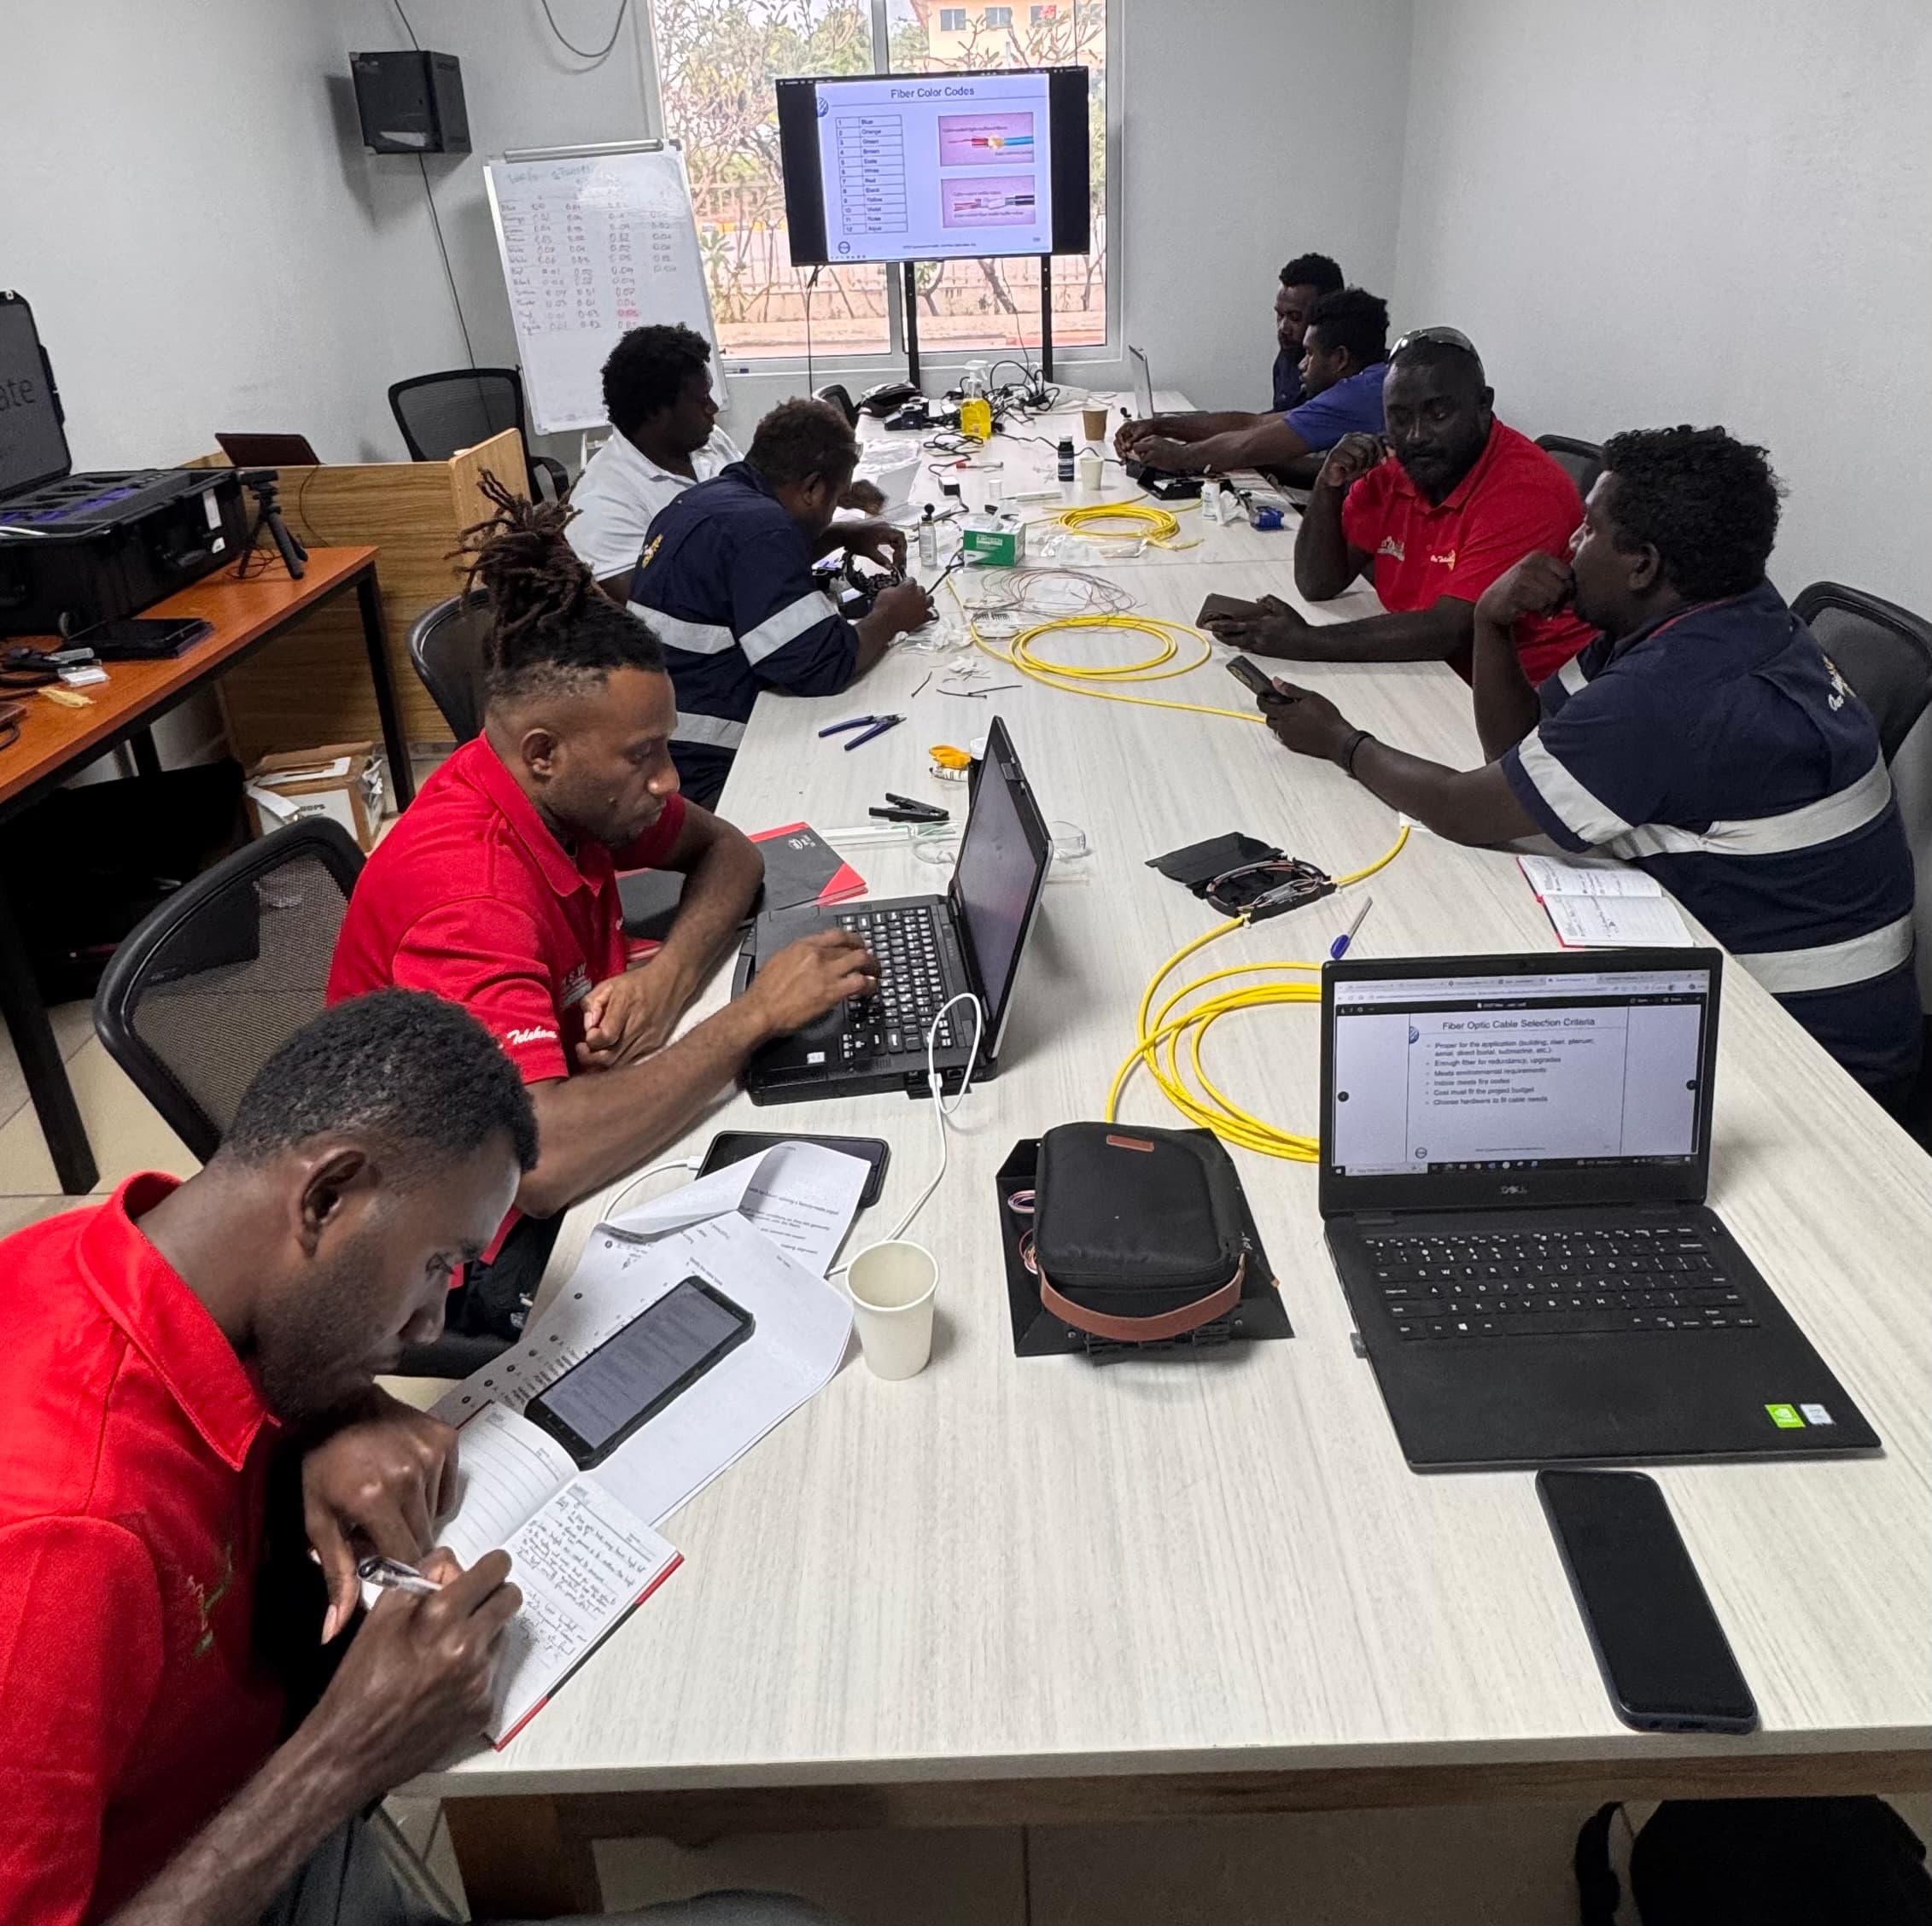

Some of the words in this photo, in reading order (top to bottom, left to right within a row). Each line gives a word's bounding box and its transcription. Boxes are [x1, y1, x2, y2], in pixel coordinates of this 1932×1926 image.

[890, 89, 914, 98] Fiber
[917, 88, 942, 97] Color
[944, 86, 975, 96] Codes
[1443, 1021, 1463, 1030] Fiber
[1468, 1021, 1490, 1030] Optic
[1492, 1020, 1518, 1029] Cable
[1521, 1018, 1561, 1027] Selection
[1564, 1018, 1595, 1026] Criteria
[1481, 1040, 1516, 1048] application
[1488, 1087, 1510, 1095] project
[1512, 1086, 1534, 1094] budget
[1501, 1185, 1527, 1194] DELL
